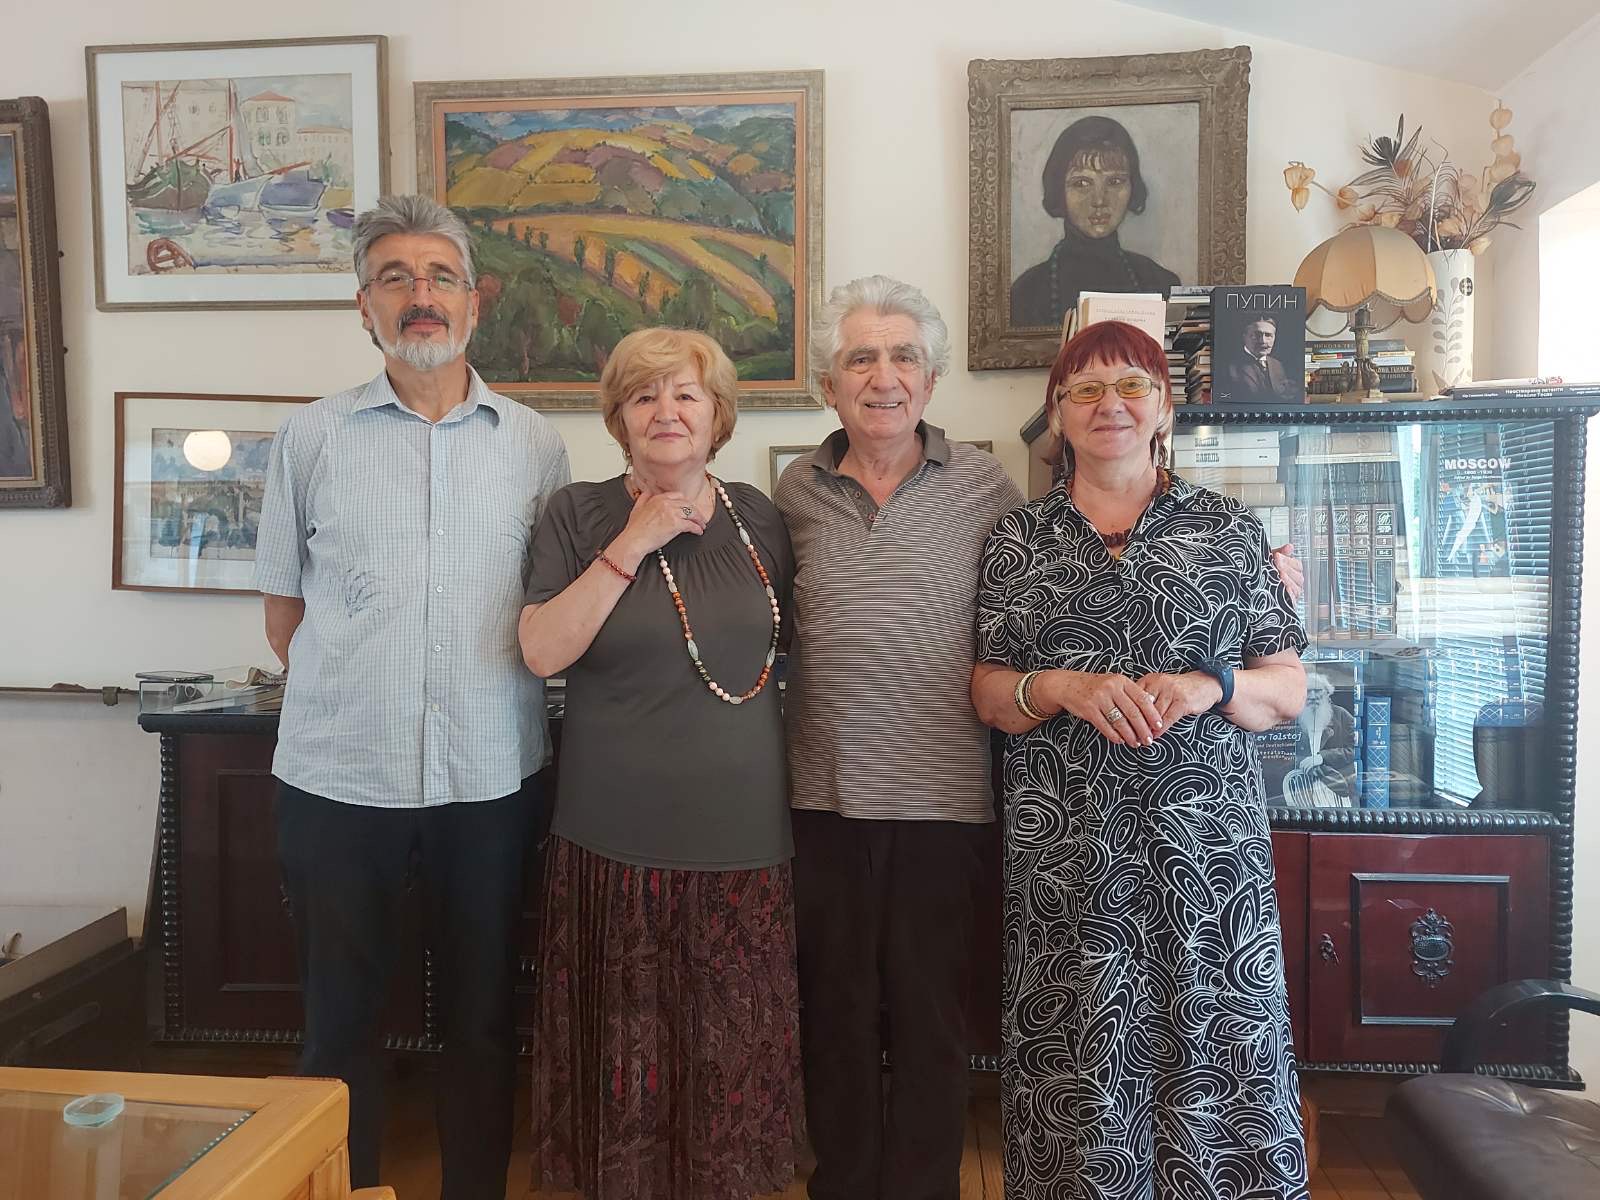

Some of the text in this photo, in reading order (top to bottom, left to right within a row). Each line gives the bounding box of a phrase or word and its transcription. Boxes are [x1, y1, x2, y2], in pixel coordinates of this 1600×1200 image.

[1226, 293, 1298, 309] ПУПИН
[1445, 458, 1511, 470] MOSCOW
[1268, 731, 1302, 742] Tolstoj
